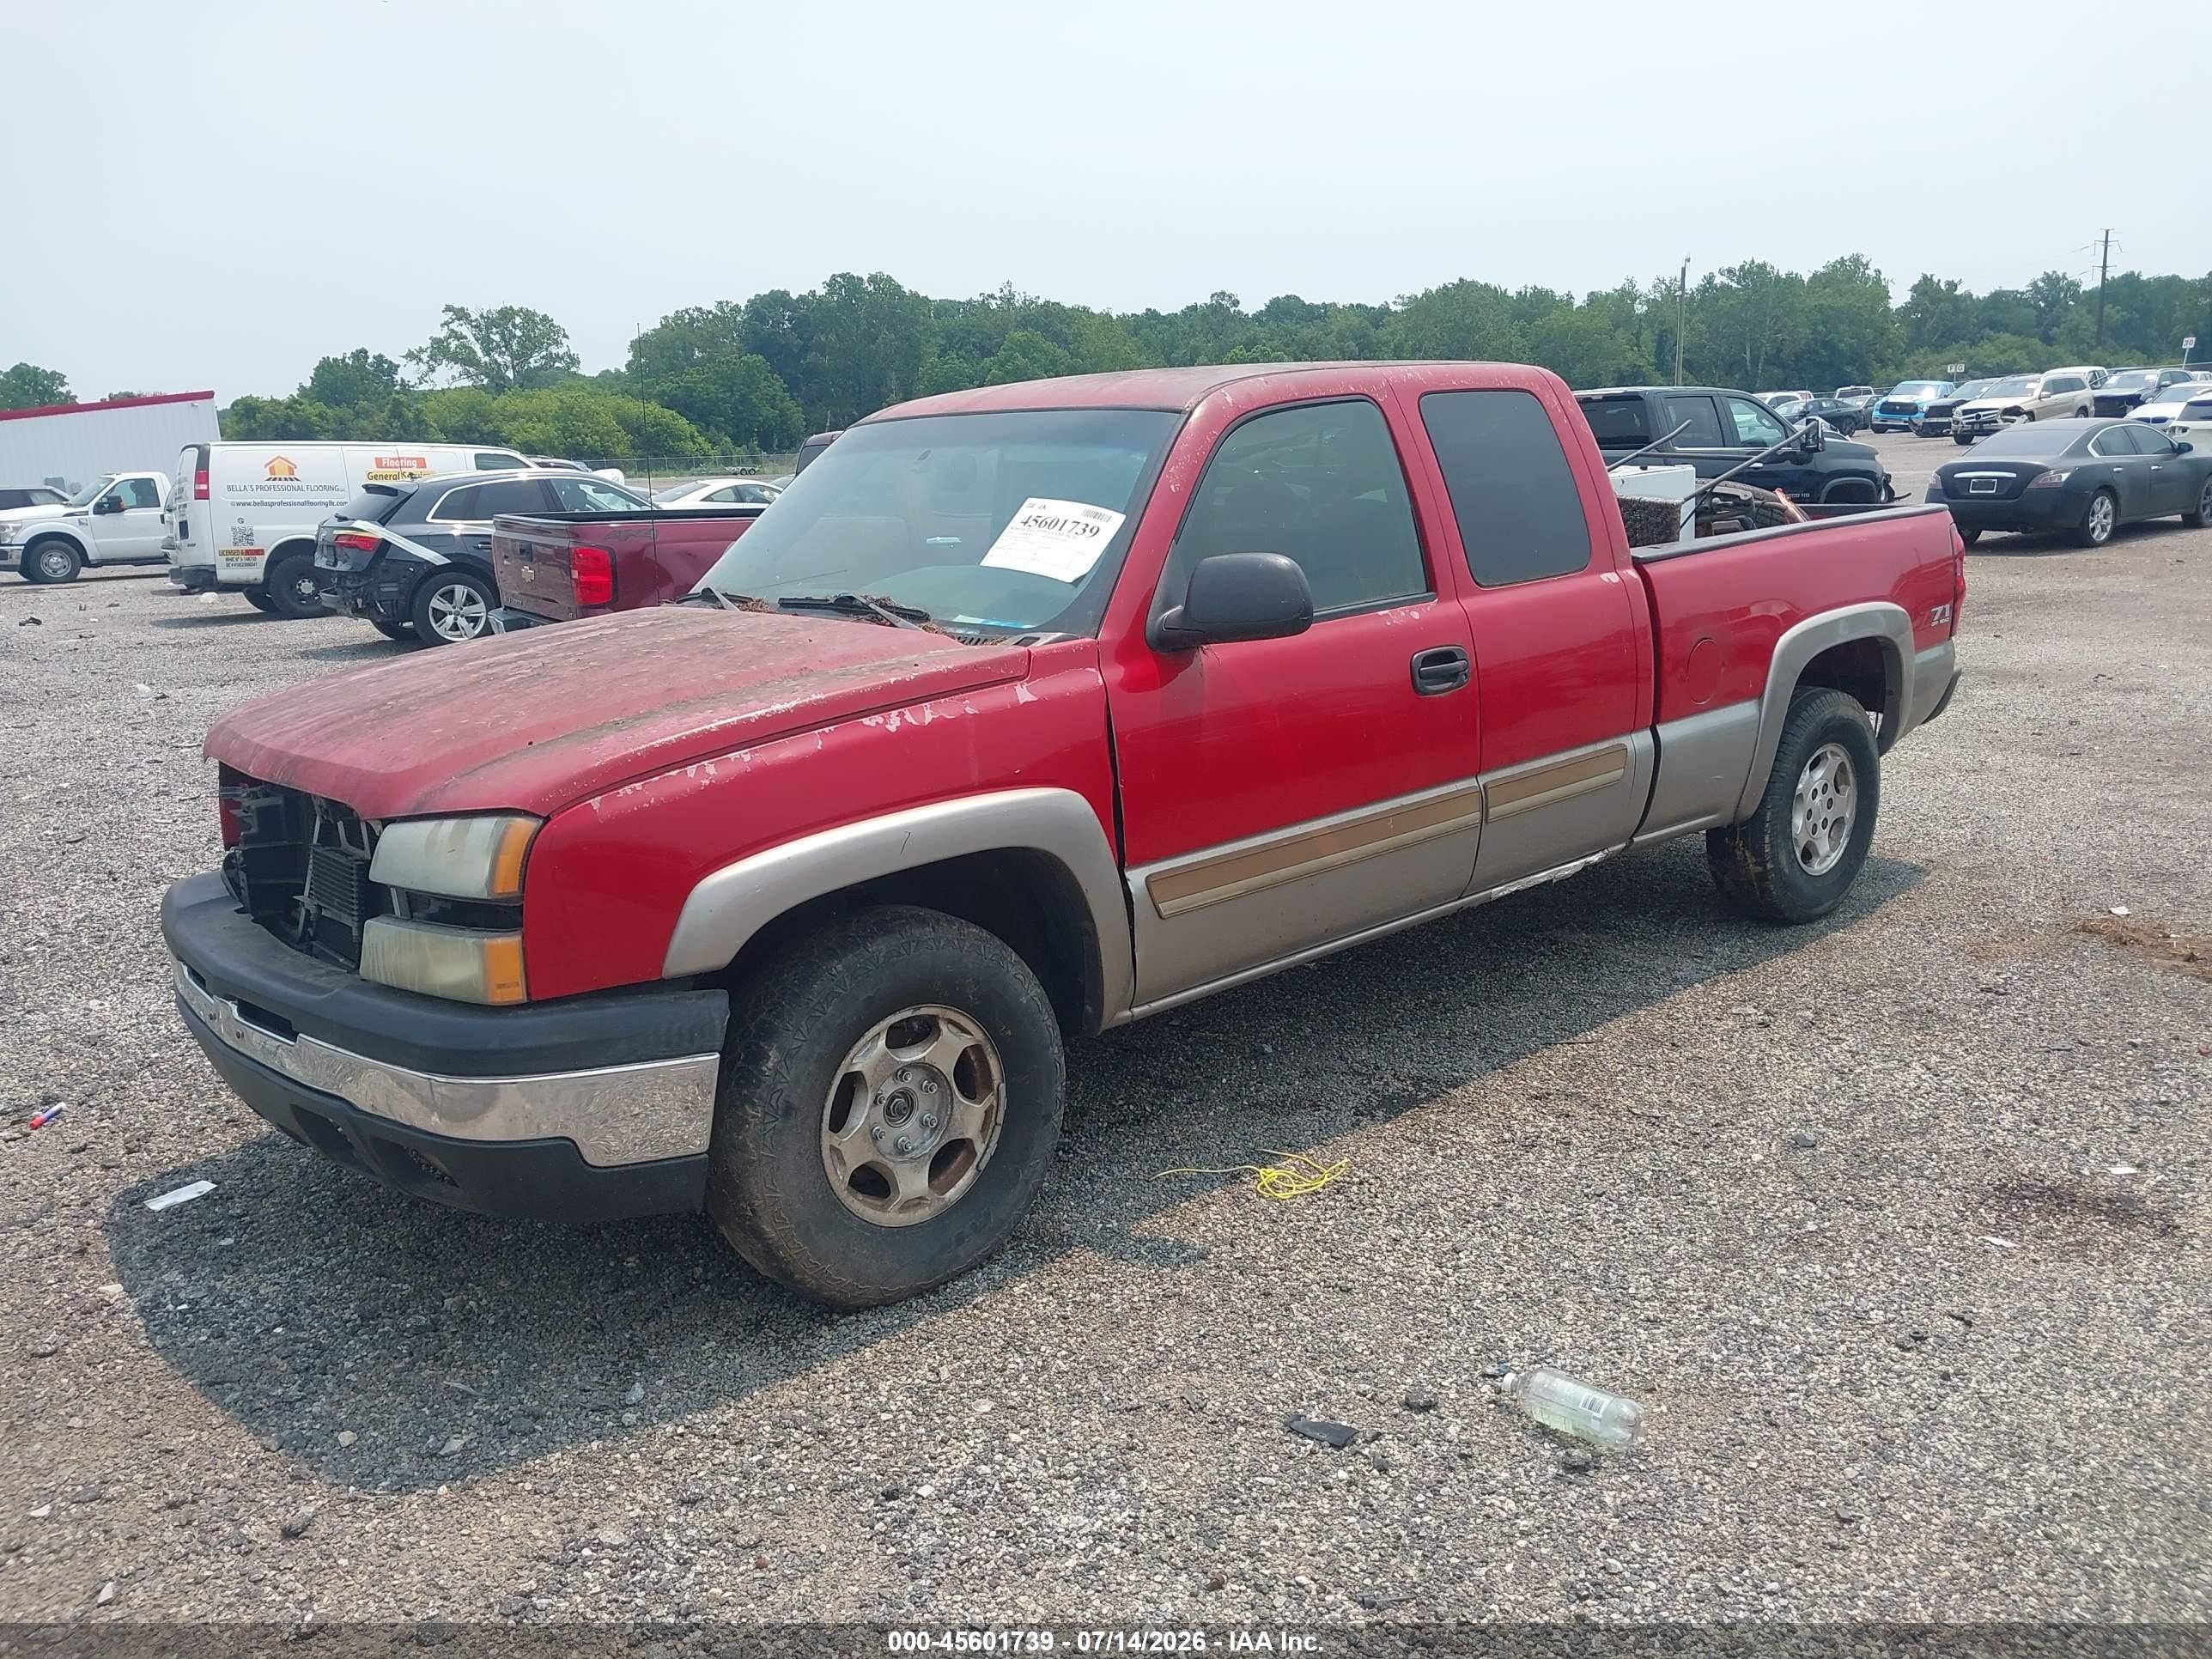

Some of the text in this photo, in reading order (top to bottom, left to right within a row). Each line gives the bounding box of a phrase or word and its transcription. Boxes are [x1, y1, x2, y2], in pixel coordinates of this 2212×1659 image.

[381, 458, 417, 468] Flooring
[367, 471, 400, 481] General
[1020, 514, 1100, 538] 45601739
